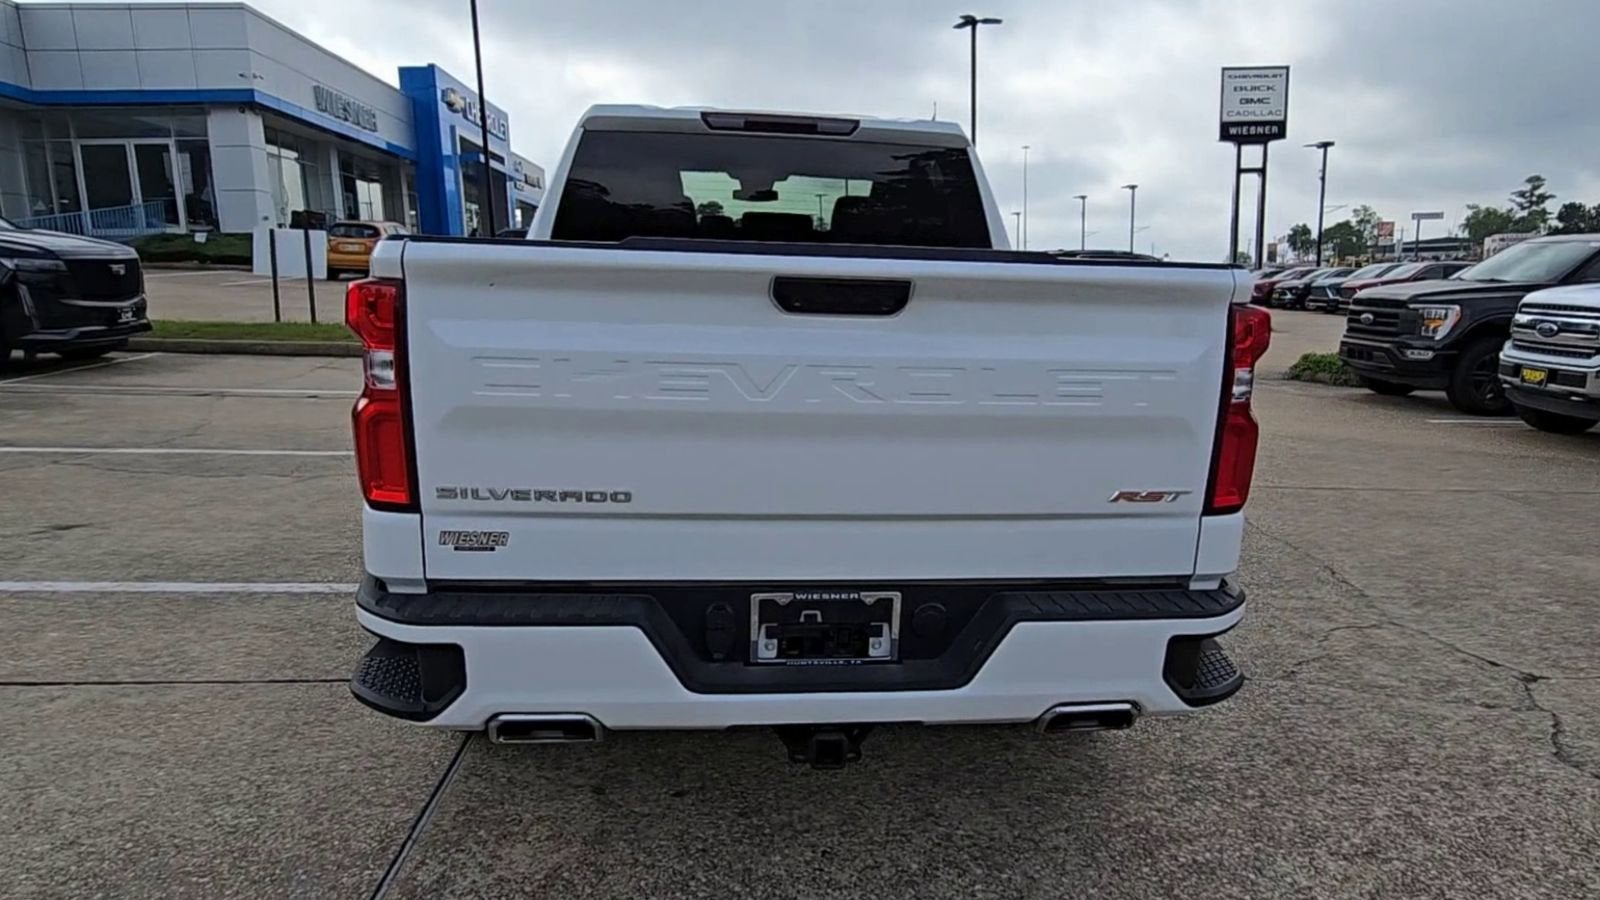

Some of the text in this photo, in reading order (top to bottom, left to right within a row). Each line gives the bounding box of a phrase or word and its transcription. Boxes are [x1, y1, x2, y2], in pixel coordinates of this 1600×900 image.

[313, 85, 378, 132] WIESNER
[1239, 97, 1271, 105] GMC
[463, 97, 506, 141] CHEROLET
[1226, 109, 1283, 117] CADILLAC
[1228, 125, 1279, 135] WIESNER
[471, 356, 1177, 406] CHEVROLET
[436, 486, 632, 503] SILVERADO
[1107, 490, 1193, 503] RST
[438, 530, 510, 547] WIESNER
[795, 592, 860, 600] WIESNER
